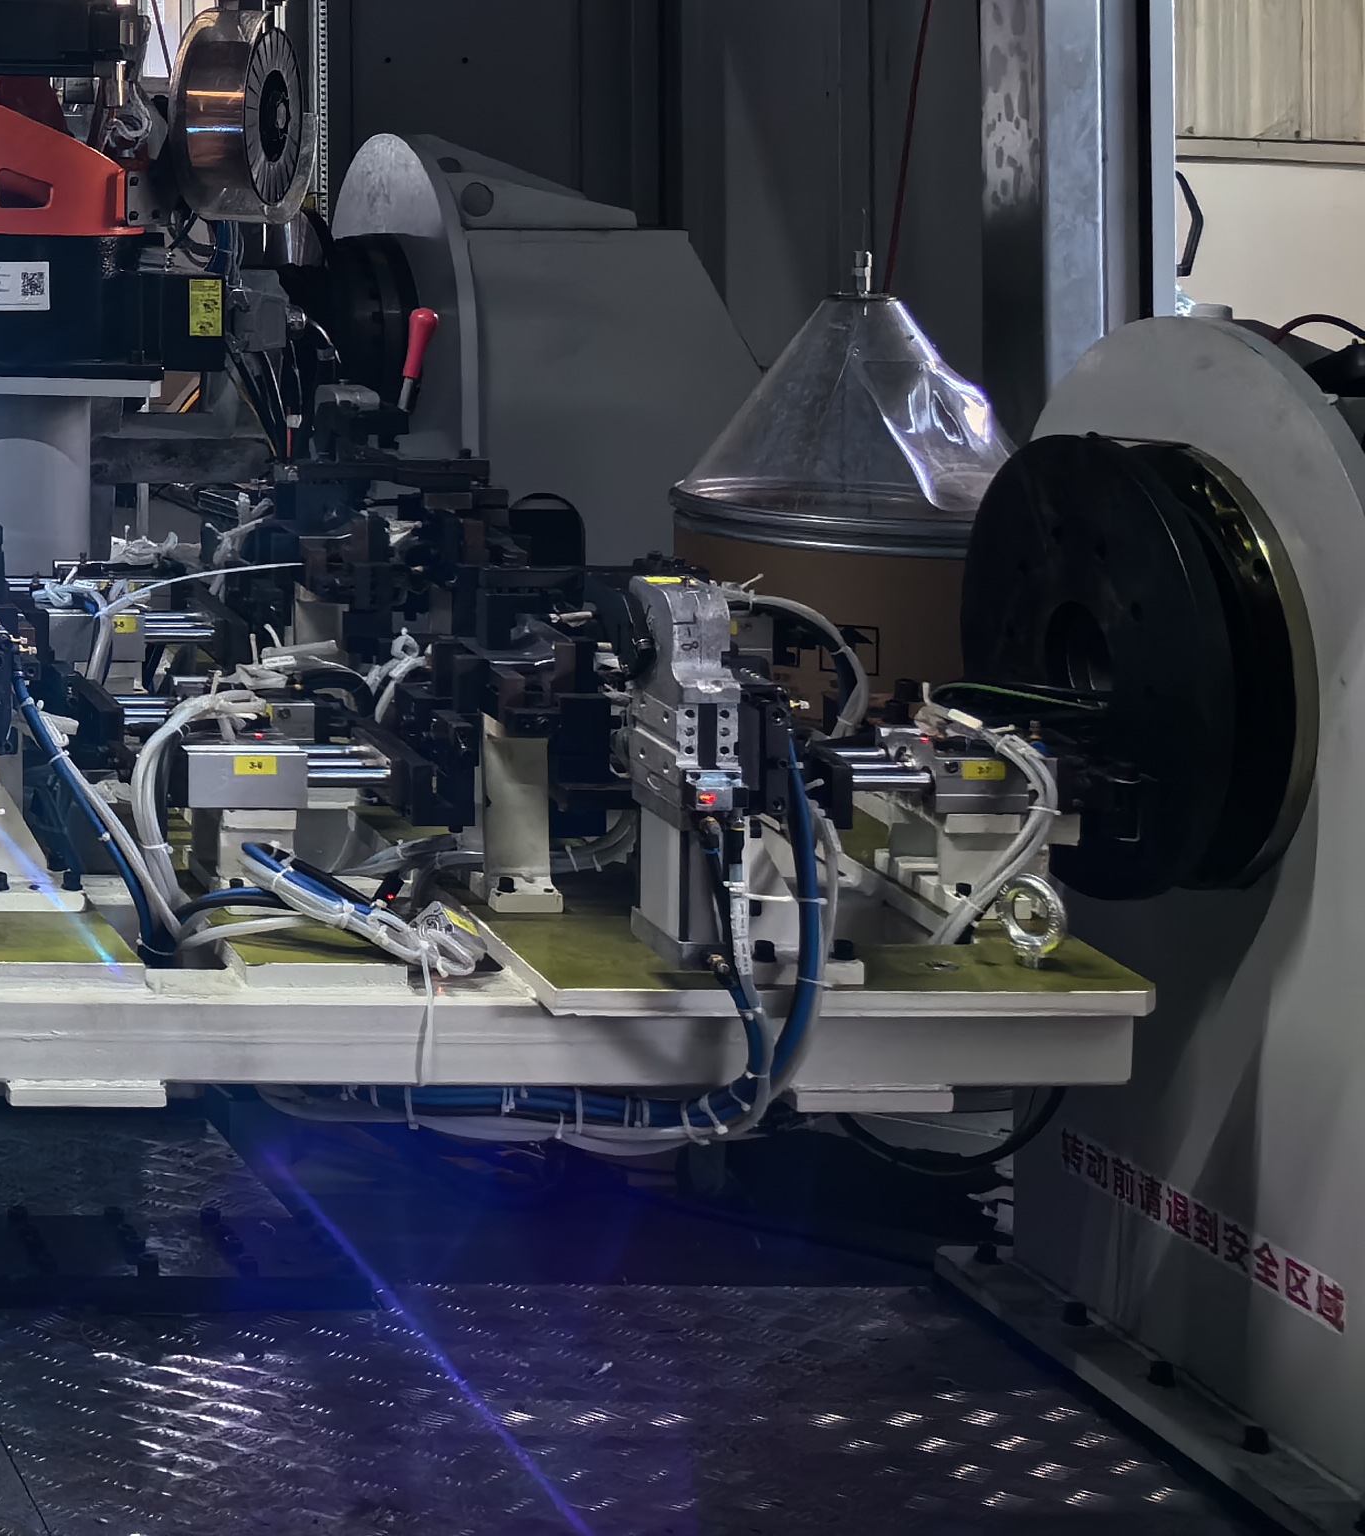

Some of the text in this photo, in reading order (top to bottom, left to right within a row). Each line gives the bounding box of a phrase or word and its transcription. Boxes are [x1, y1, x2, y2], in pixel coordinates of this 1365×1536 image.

[1061, 1127, 1345, 1334] 转动前请退到安全区域
